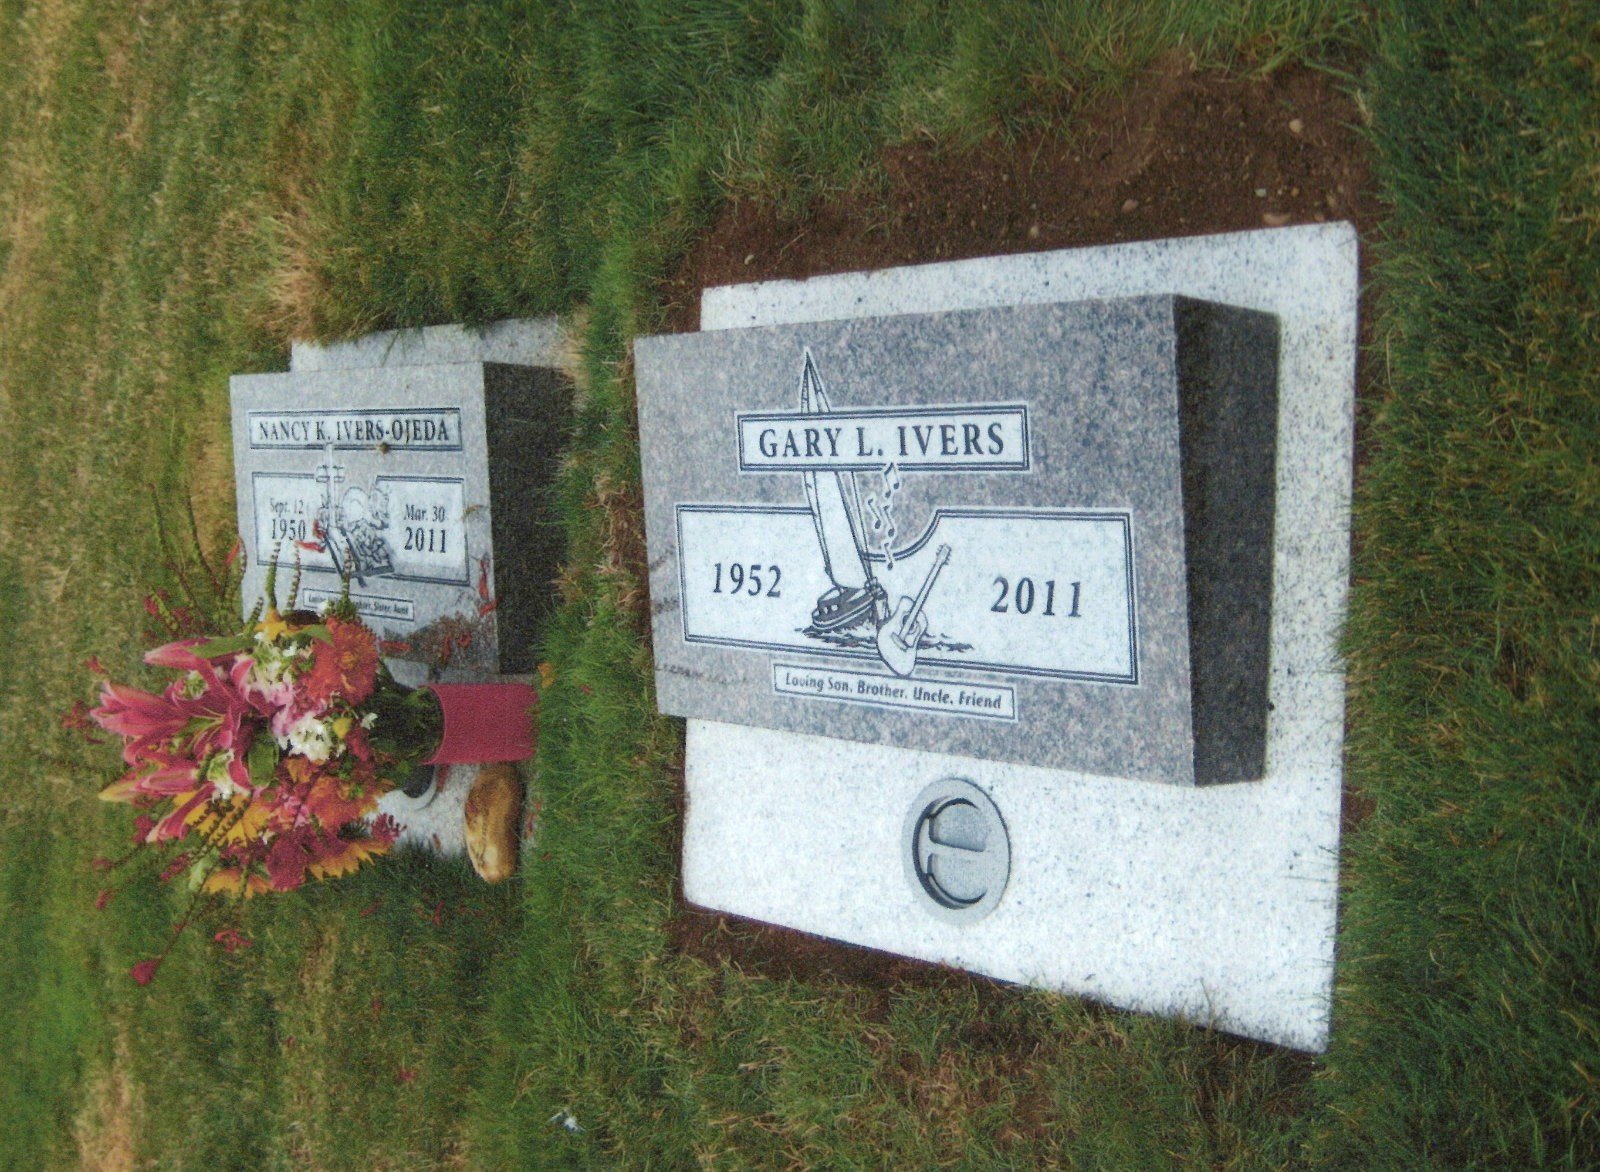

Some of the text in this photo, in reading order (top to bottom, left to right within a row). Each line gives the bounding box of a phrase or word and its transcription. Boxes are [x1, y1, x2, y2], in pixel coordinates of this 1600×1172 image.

[259, 418, 450, 442] NANCY K. IVERS-OJEDA
[759, 422, 1004, 457] GARY L. IVERS
[404, 504, 446, 523] Mar. 30
[271, 518, 306, 541] 1950
[404, 526, 446, 553] 2011
[713, 562, 782, 598] 1952
[990, 576, 1082, 617] 2011
[785, 672, 824, 692] Loving
[959, 690, 1002, 709] Friend
